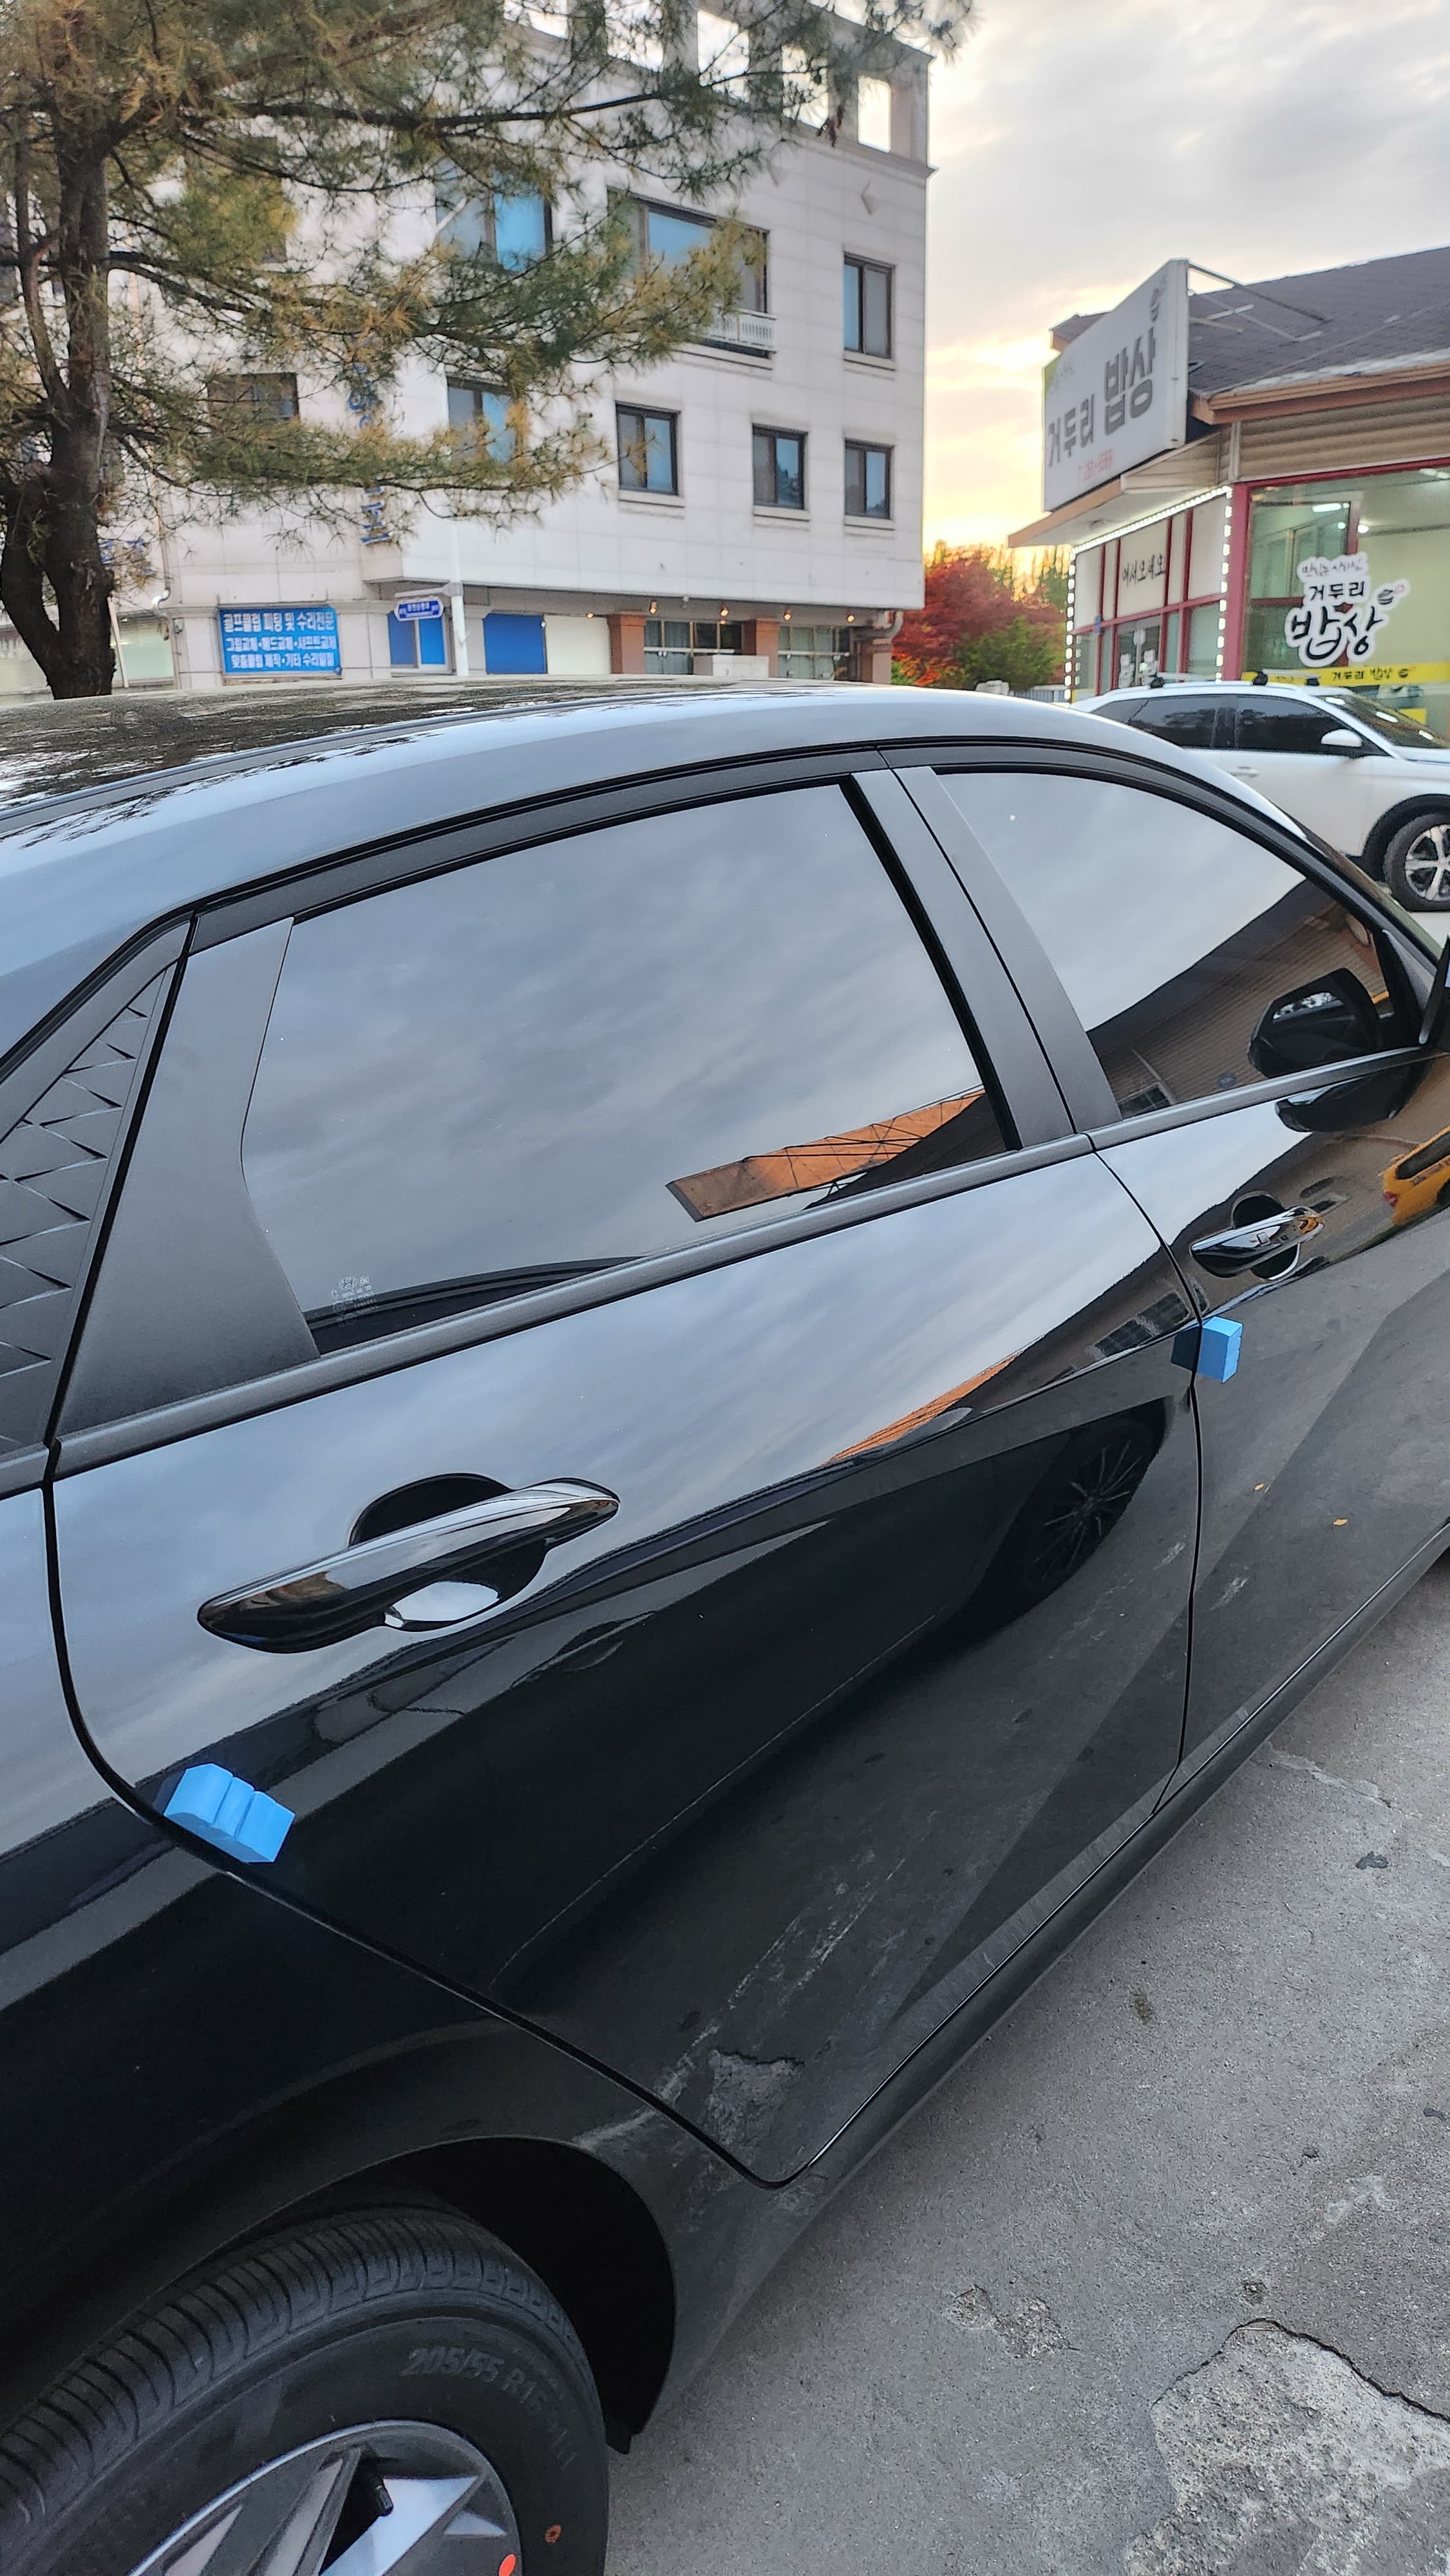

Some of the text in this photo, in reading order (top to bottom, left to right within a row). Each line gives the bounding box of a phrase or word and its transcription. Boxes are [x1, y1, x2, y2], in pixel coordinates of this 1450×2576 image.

[1048, 327, 1156, 468] 거두리 밥상
[1309, 581, 1365, 601] 거두리
[1291, 605, 1384, 660] 밥상
[1332, 670, 1365, 680] 거두리
